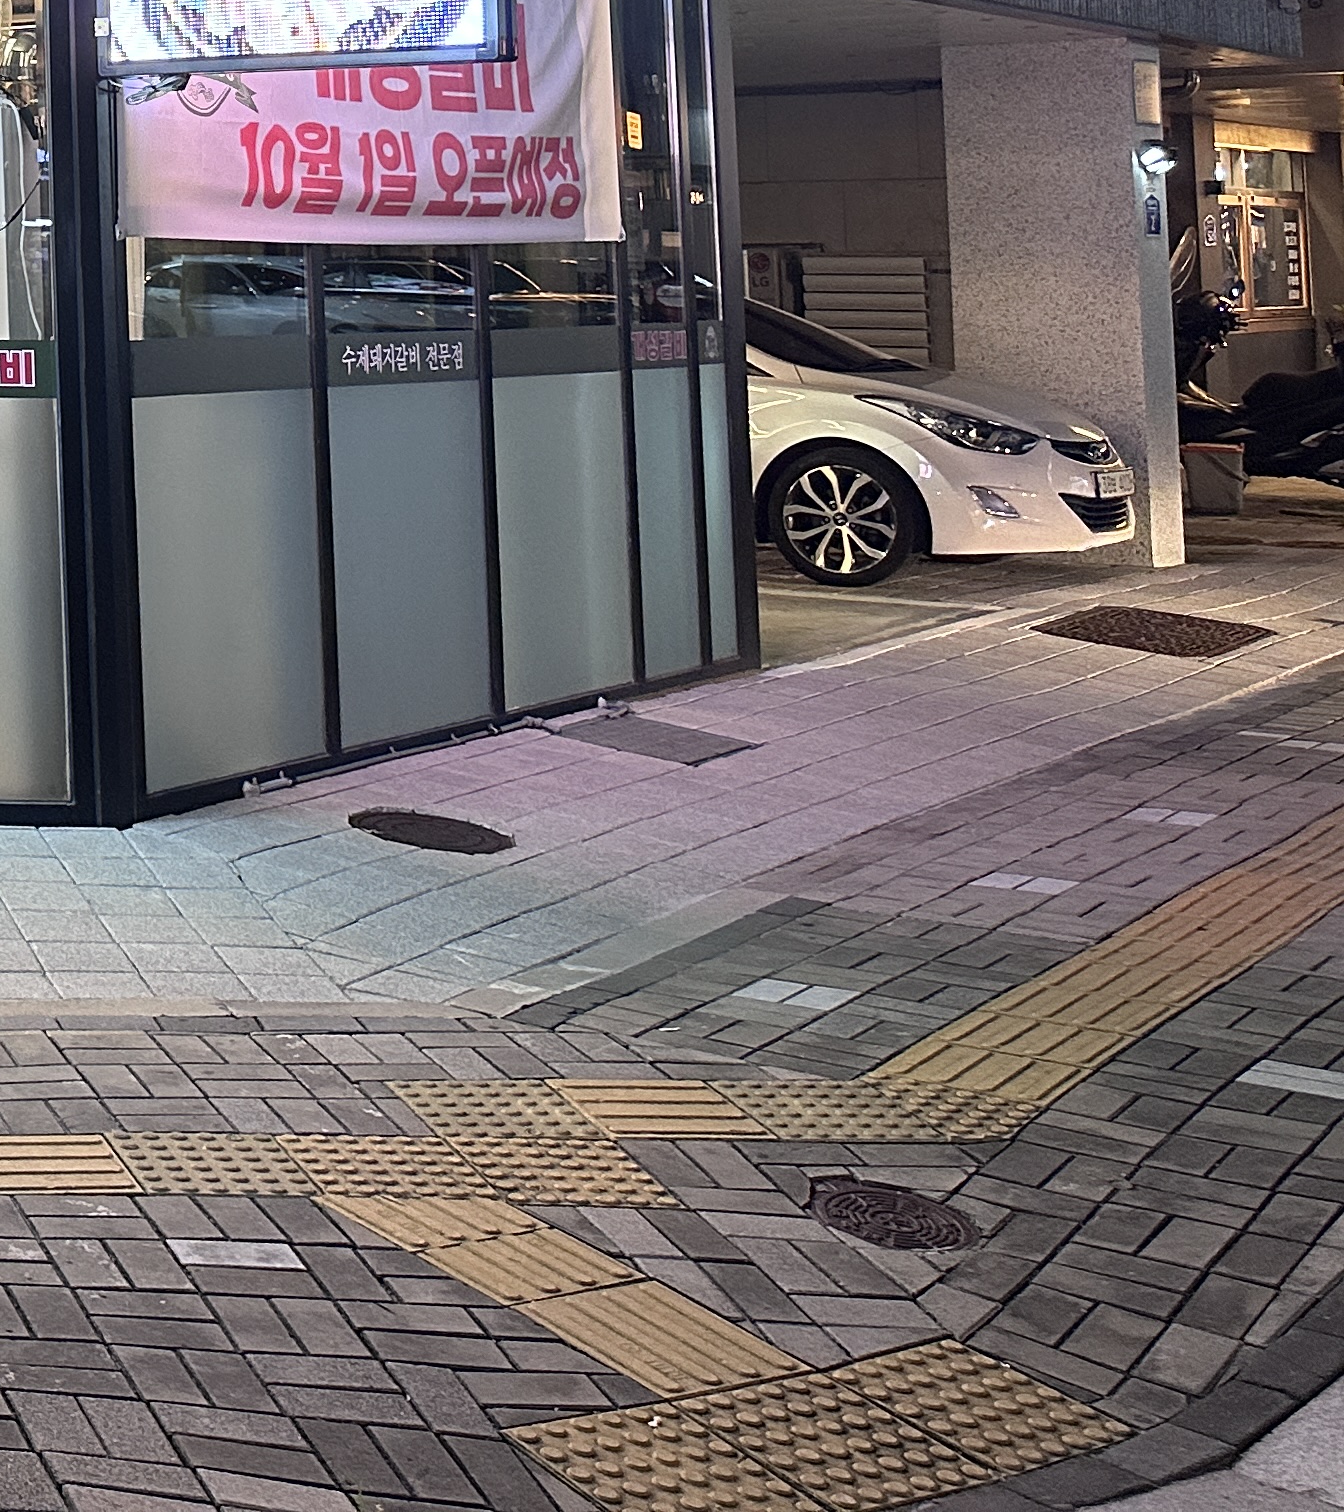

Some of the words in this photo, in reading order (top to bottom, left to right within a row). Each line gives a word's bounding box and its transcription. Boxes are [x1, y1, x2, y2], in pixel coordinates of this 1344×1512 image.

[239, 121, 343, 215] 10월
[356, 129, 417, 216] 1일
[423, 132, 582, 219] 오픈예정
[752, 276, 769, 287] LG
[342, 342, 421, 376] 수제돼지갈비
[425, 341, 463, 371] 전문점
